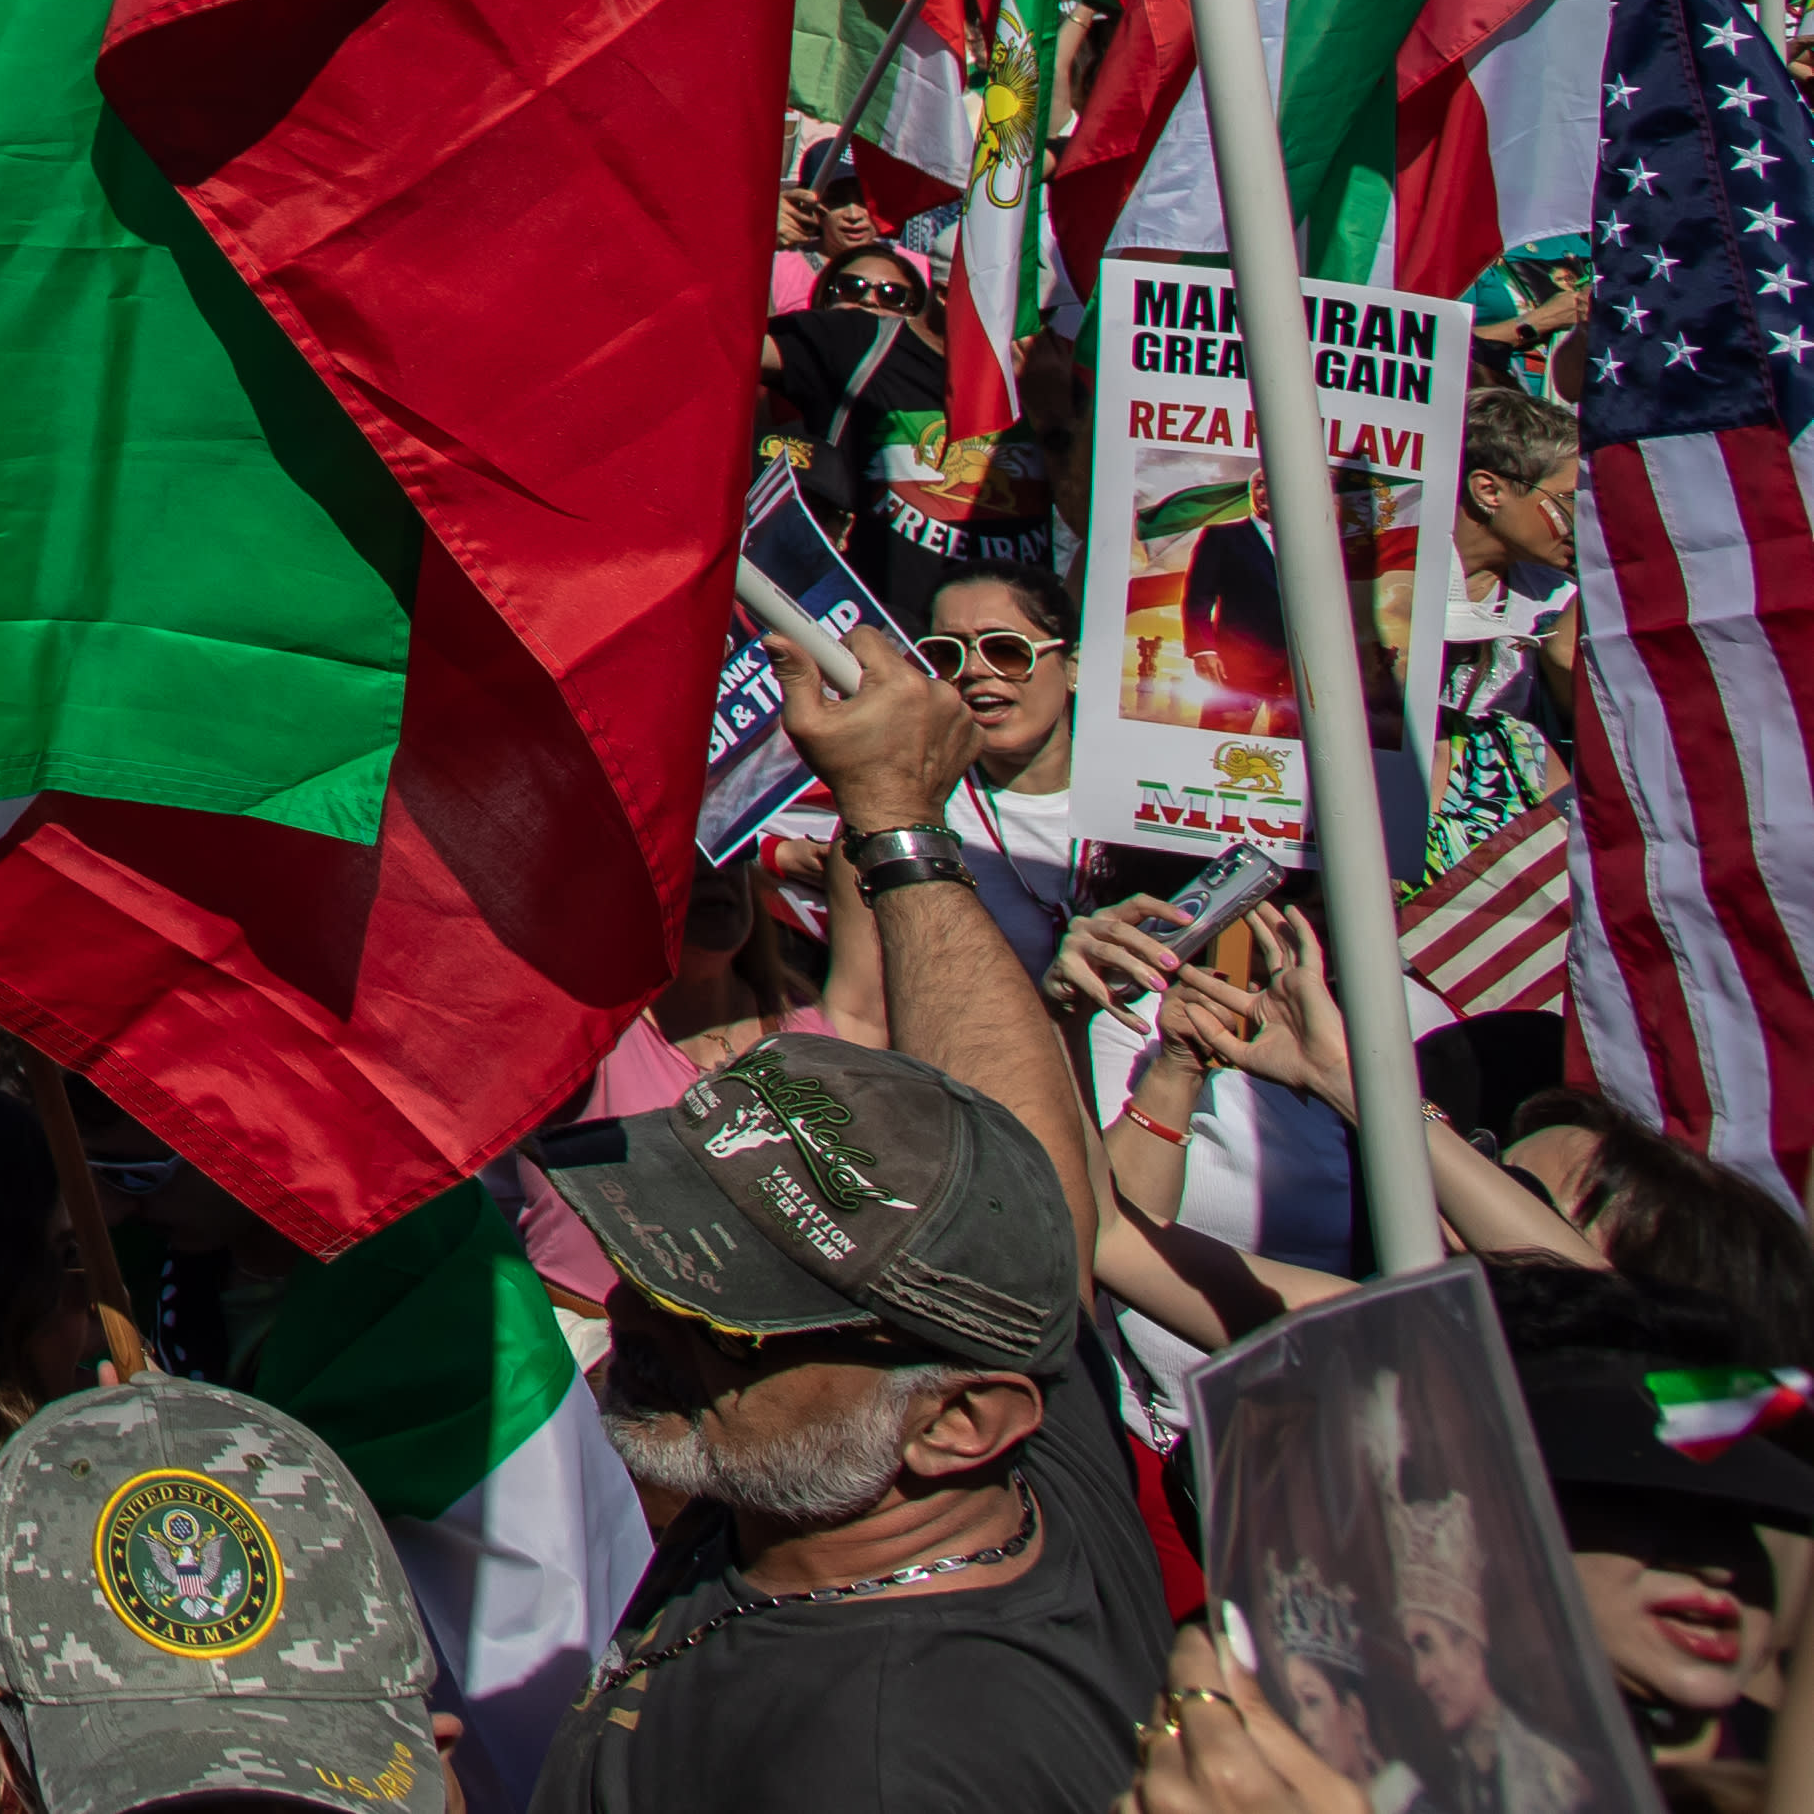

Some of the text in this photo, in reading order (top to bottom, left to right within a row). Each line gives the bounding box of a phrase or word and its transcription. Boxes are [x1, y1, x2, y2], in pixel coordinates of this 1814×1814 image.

[1302, 294, 1438, 361] IRAN
[1132, 331, 1433, 404] GREA GAIN
[1129, 400, 1424, 471] REZA PLAVI
[874, 489, 1048, 562] FREE IRAN
[717, 650, 761, 703] ANK
[708, 711, 740, 764] BI
[730, 704, 757, 729] &
[1134, 780, 1303, 842] MIG
[1129, 1110, 1150, 1128] IRAN
[771, 1165, 857, 1253] VARIATION
[114, 1485, 255, 1543] UNITED STATES
[162, 1621, 240, 1645] ARMY
[316, 1766, 381, 1801] U.S.
